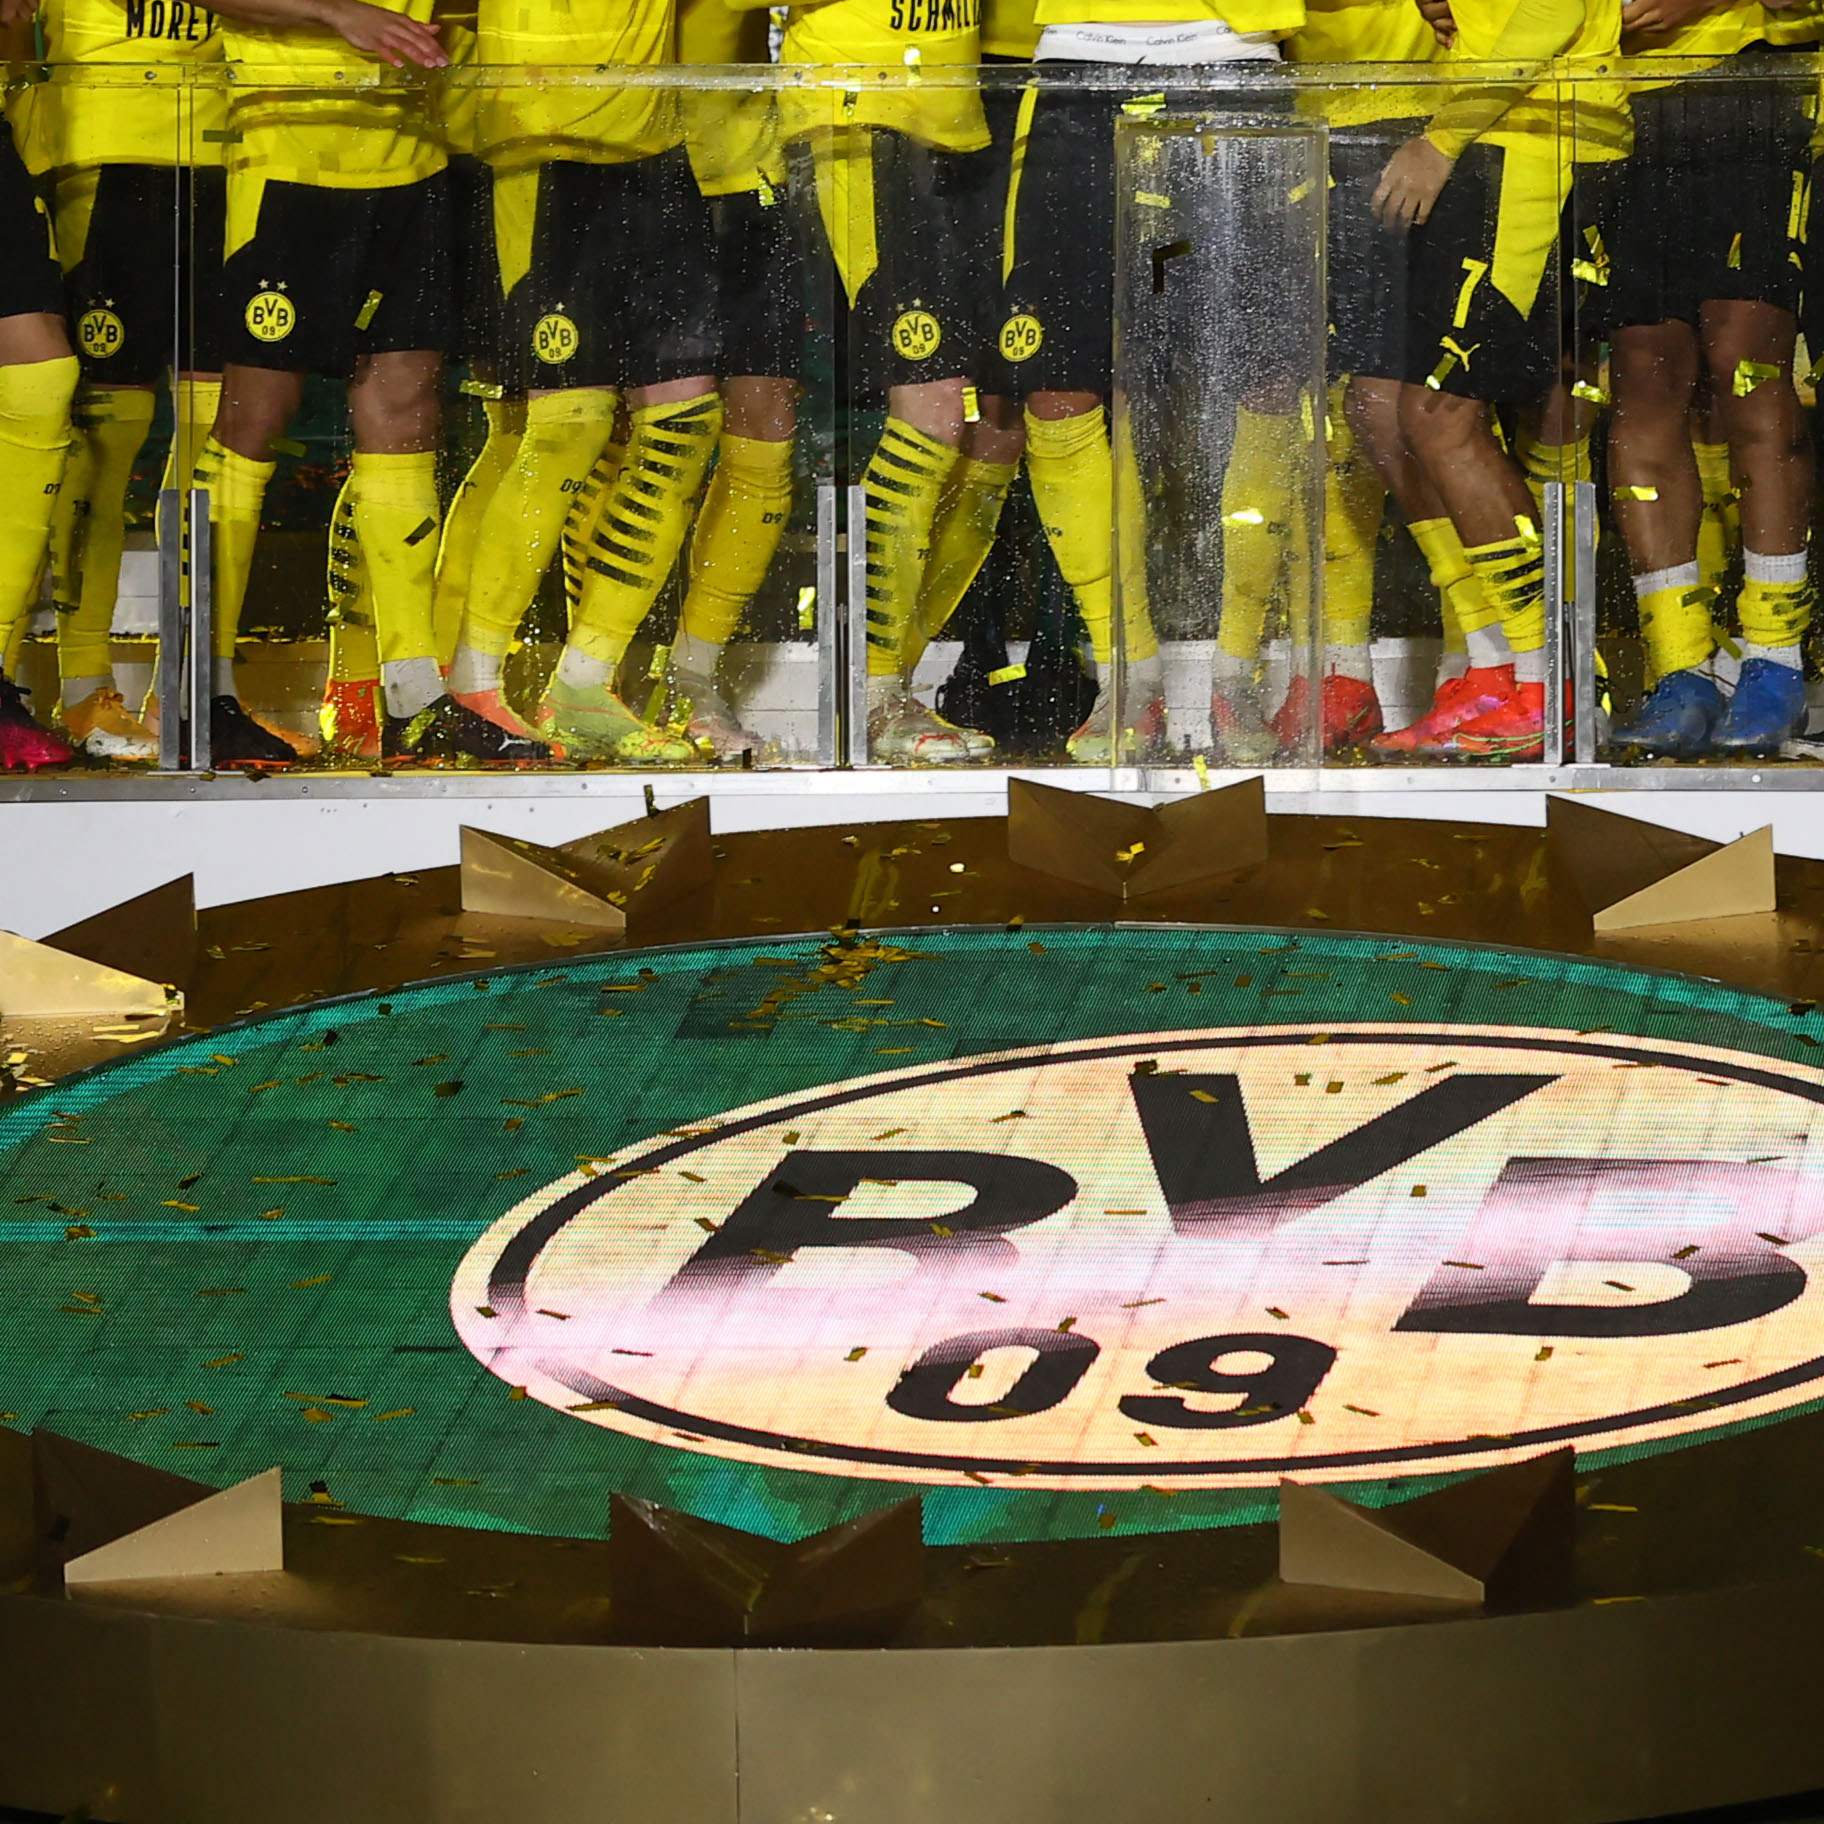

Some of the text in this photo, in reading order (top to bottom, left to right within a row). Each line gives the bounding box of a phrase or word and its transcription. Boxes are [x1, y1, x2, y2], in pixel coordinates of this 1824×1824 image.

[1452, 256, 1488, 330] 7
[253, 298, 288, 327] BVB
[84, 314, 118, 343] BVB
[538, 319, 572, 349] BVB
[899, 316, 934, 348] BVB
[1006, 320, 1036, 348] BVB
[884, 1327, 1339, 1430] 09
